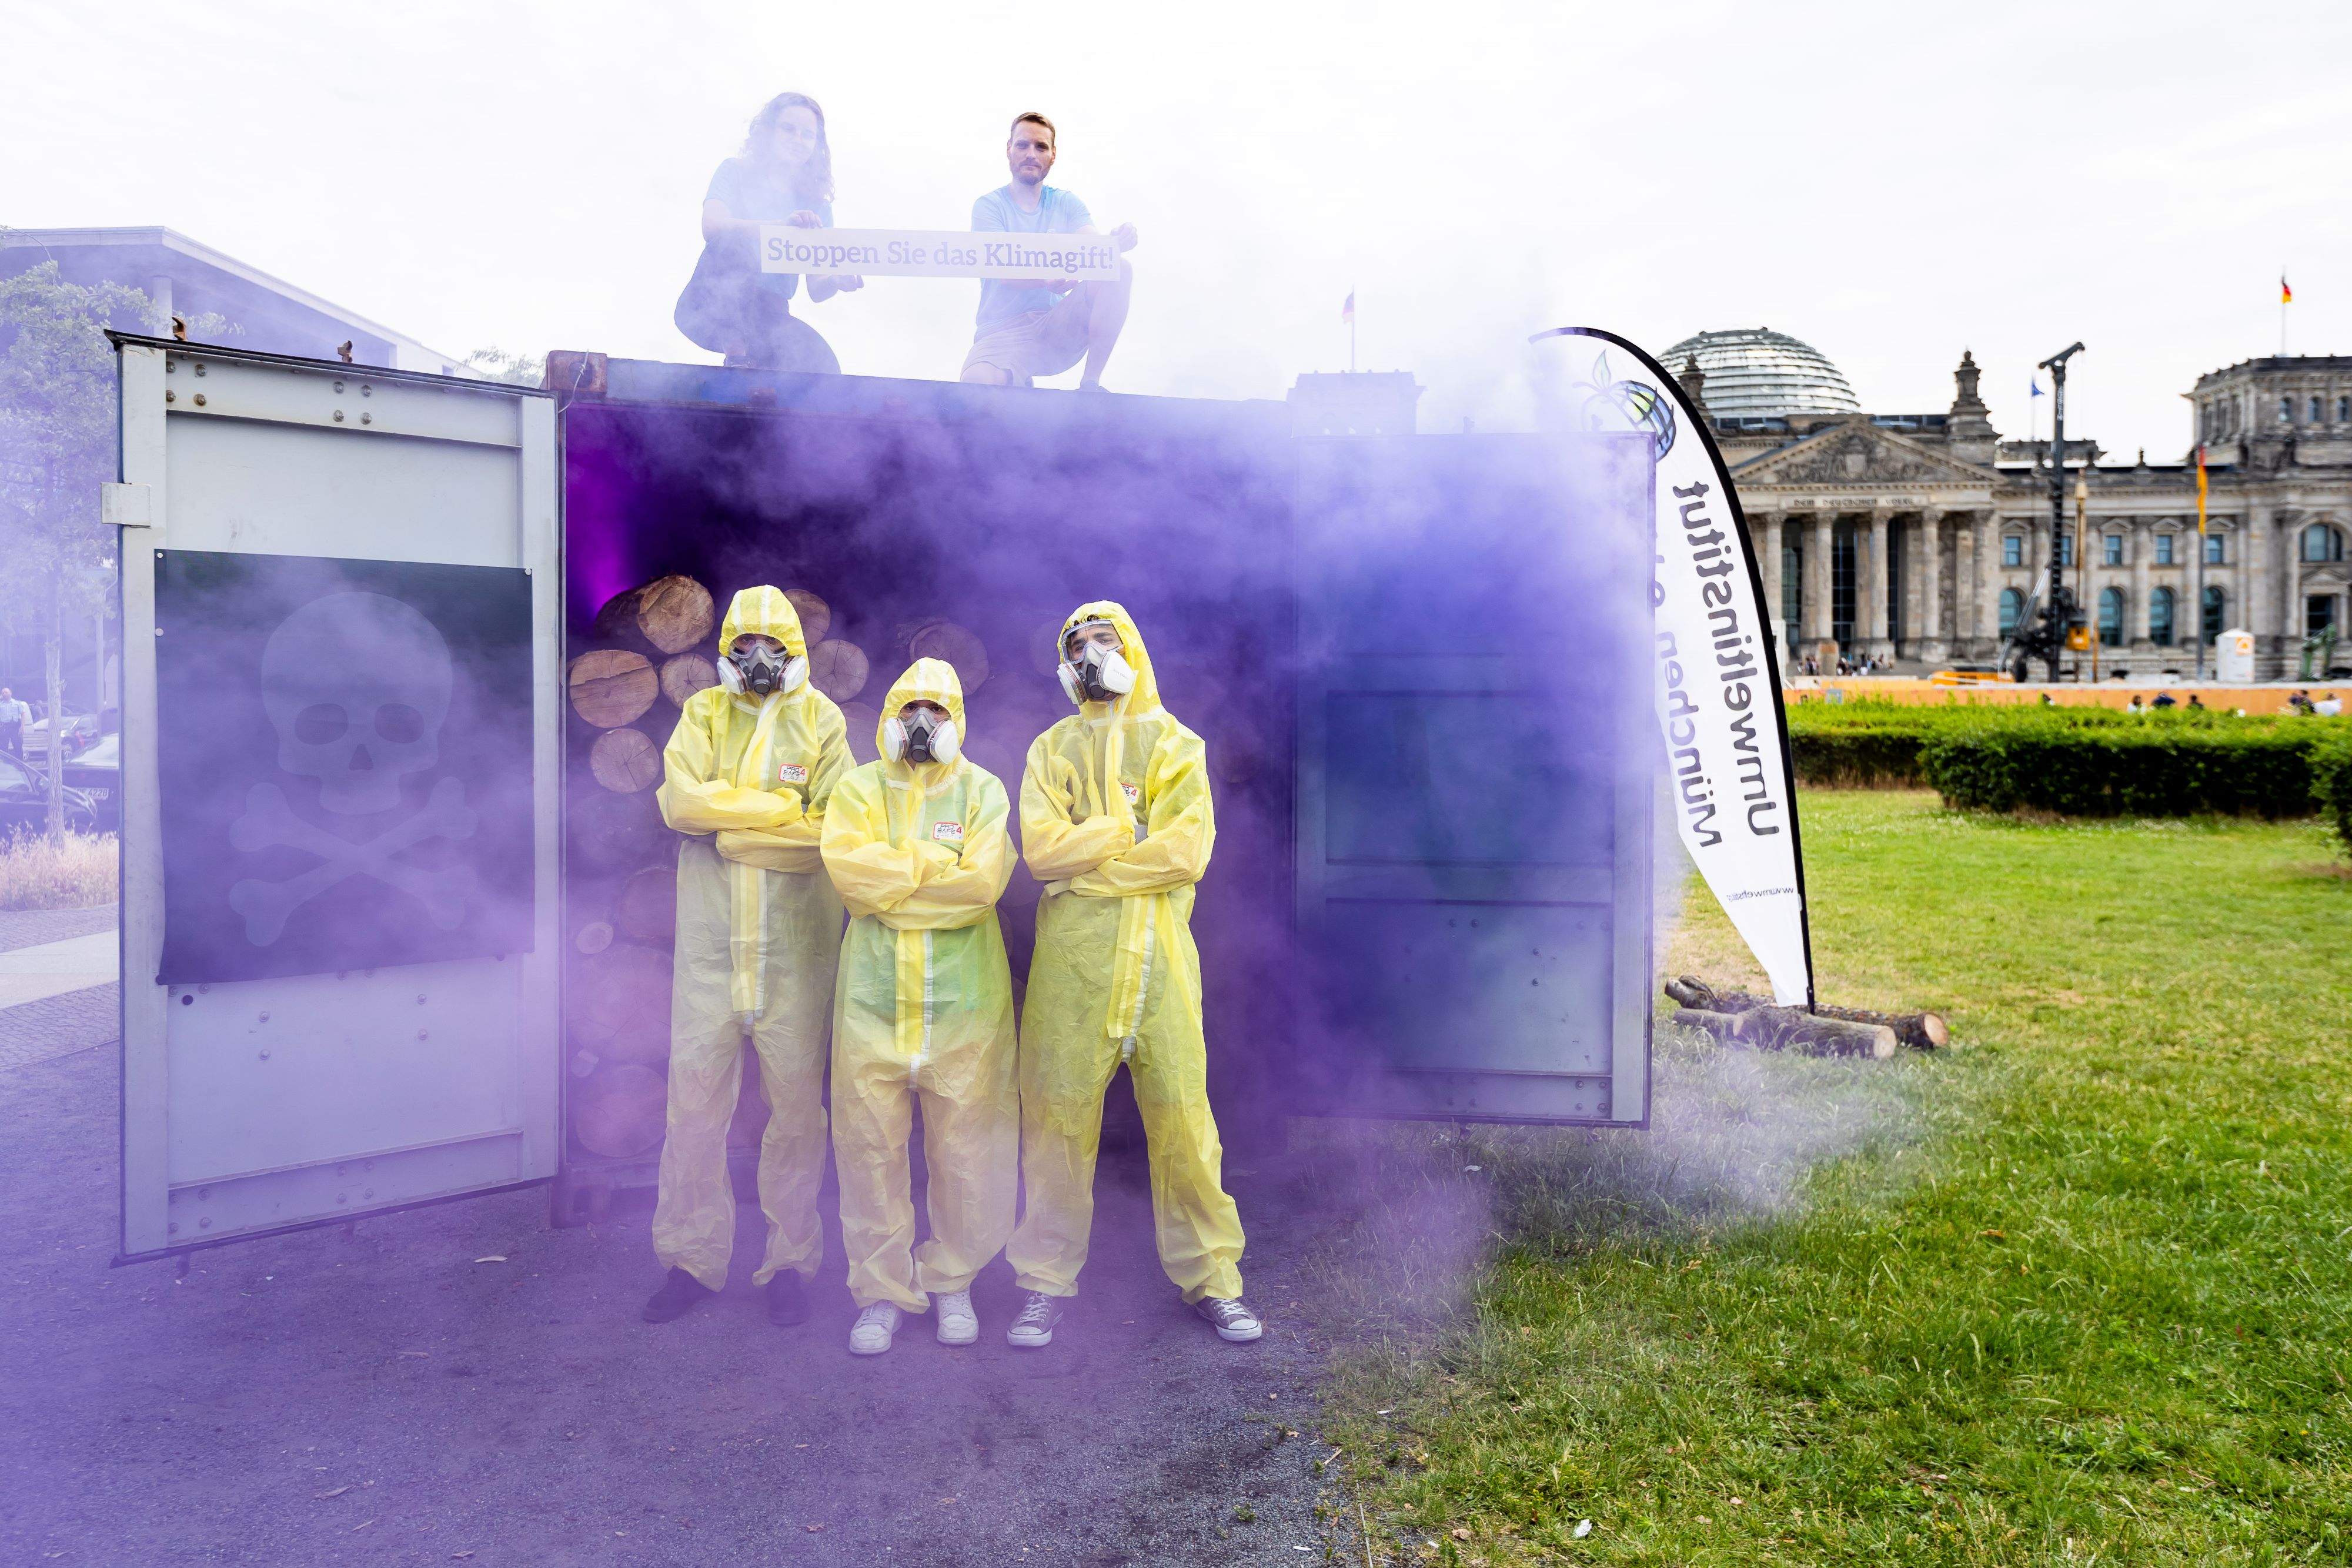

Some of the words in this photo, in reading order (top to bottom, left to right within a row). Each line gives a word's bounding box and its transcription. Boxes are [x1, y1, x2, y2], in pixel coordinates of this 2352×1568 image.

[767, 237, 879, 268] Stoppen
[887, 240, 927, 266] Sie
[933, 242, 977, 267] das
[984, 242, 1114, 274] Klimagift!
